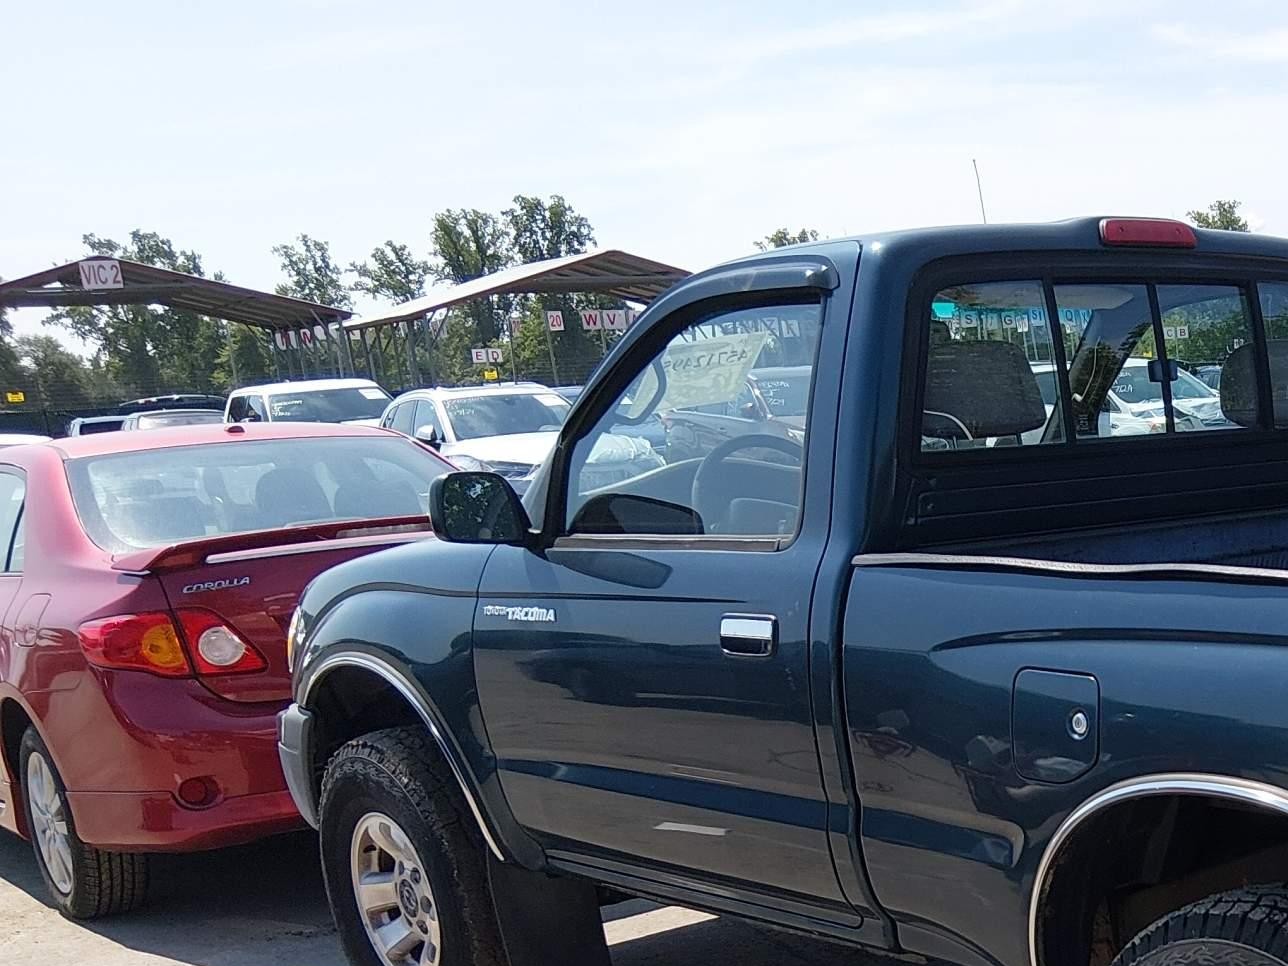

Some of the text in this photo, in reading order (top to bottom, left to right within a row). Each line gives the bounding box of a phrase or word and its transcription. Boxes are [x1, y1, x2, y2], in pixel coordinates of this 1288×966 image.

[81, 264, 122, 285] VIC 2
[550, 315, 562, 328] 20
[583, 314, 598, 327] W
[604, 313, 617, 326] V
[965, 315, 974, 325] S
[1003, 315, 1013, 326] G
[1166, 328, 1174, 338] C
[1178, 328, 1187, 338] B
[475, 351, 484, 361] E
[491, 351, 500, 361] D
[182, 576, 250, 594] COROLLA
[483, 604, 556, 622] TOYOTA TACOMA
